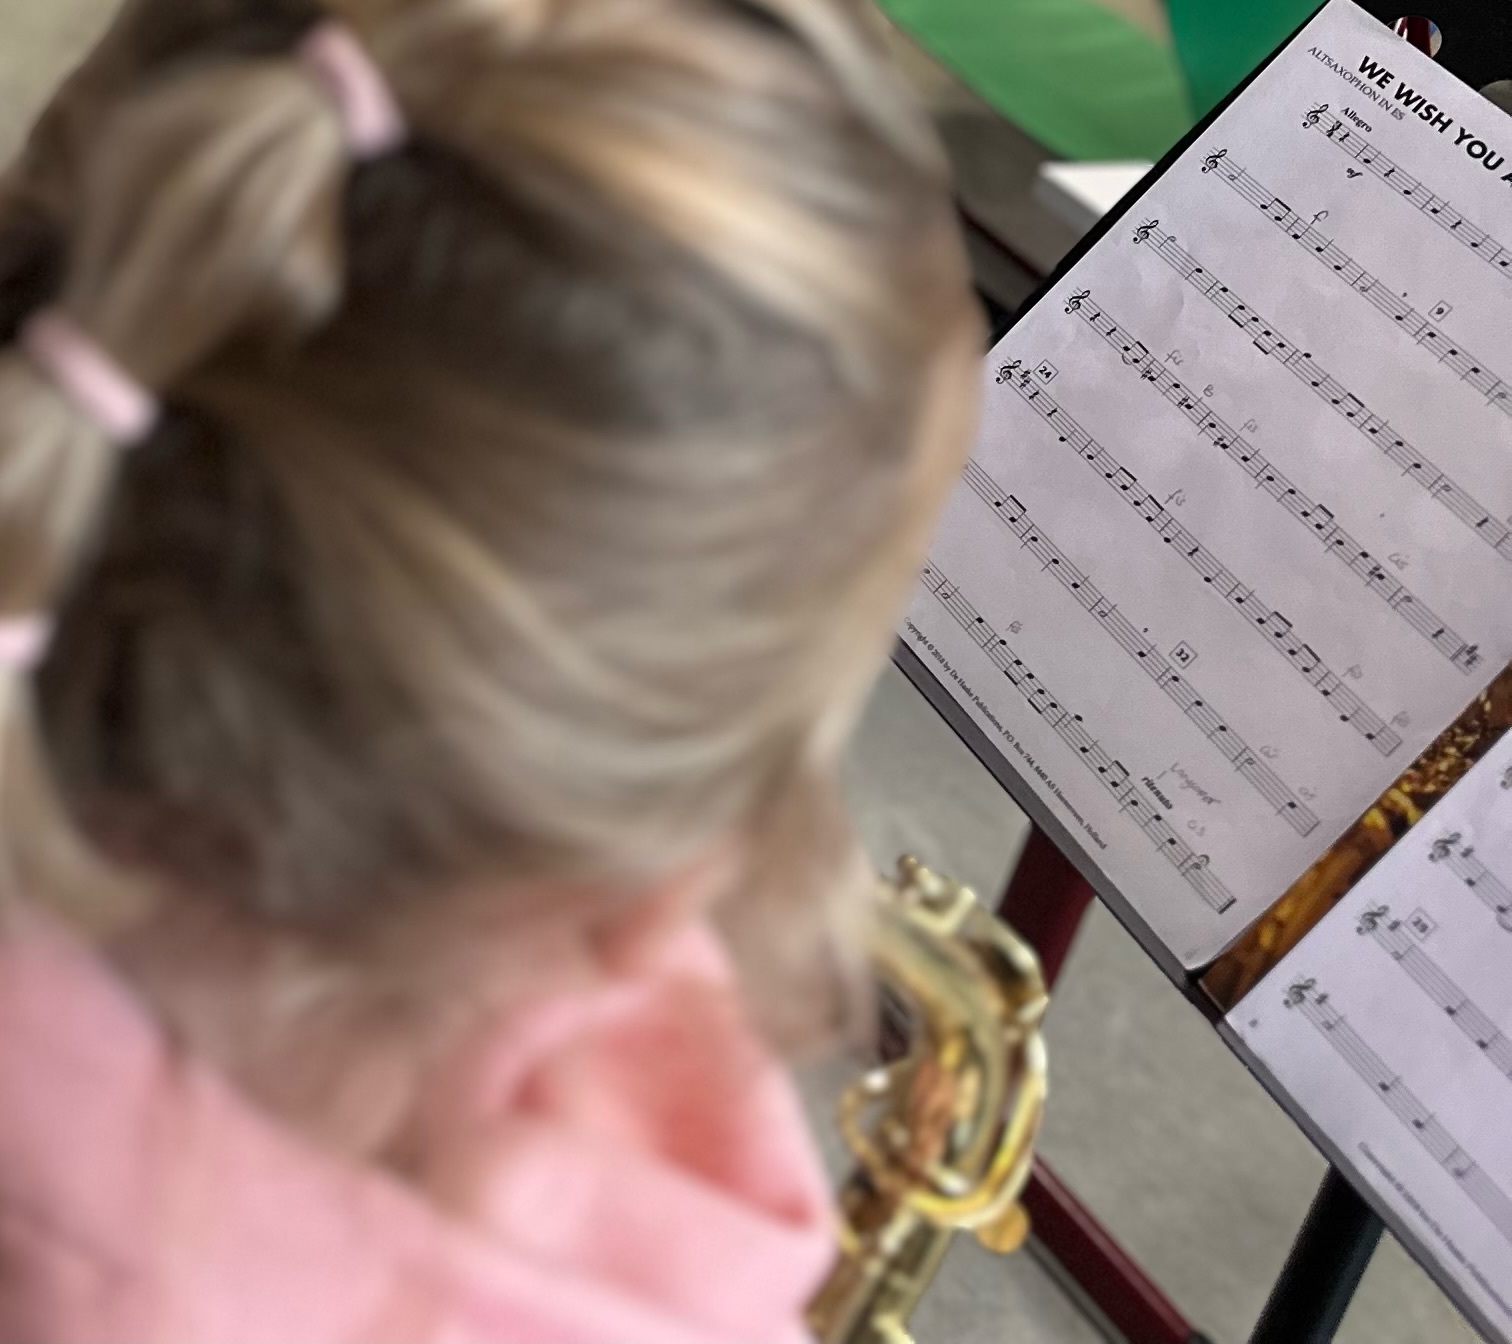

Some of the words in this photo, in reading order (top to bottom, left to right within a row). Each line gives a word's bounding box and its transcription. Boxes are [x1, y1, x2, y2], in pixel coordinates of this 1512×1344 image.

[1307, 46, 1381, 102] ALTSAXOPHON
[1377, 97, 1394, 112] IN
[1390, 107, 1406, 121] ES
[1340, 106, 1373, 133] Allegro
[1358, 55, 1395, 90] WE
[1394, 81, 1454, 134] WISH
[1453, 127, 1505, 171] YOU
[1435, 307, 1445, 316] 9
[1038, 365, 1053, 379] 24
[1175, 647, 1190, 663] 32
[942, 661, 952, 672] by
[949, 669, 959, 681] De
[1141, 776, 1173, 810] ritenuto
